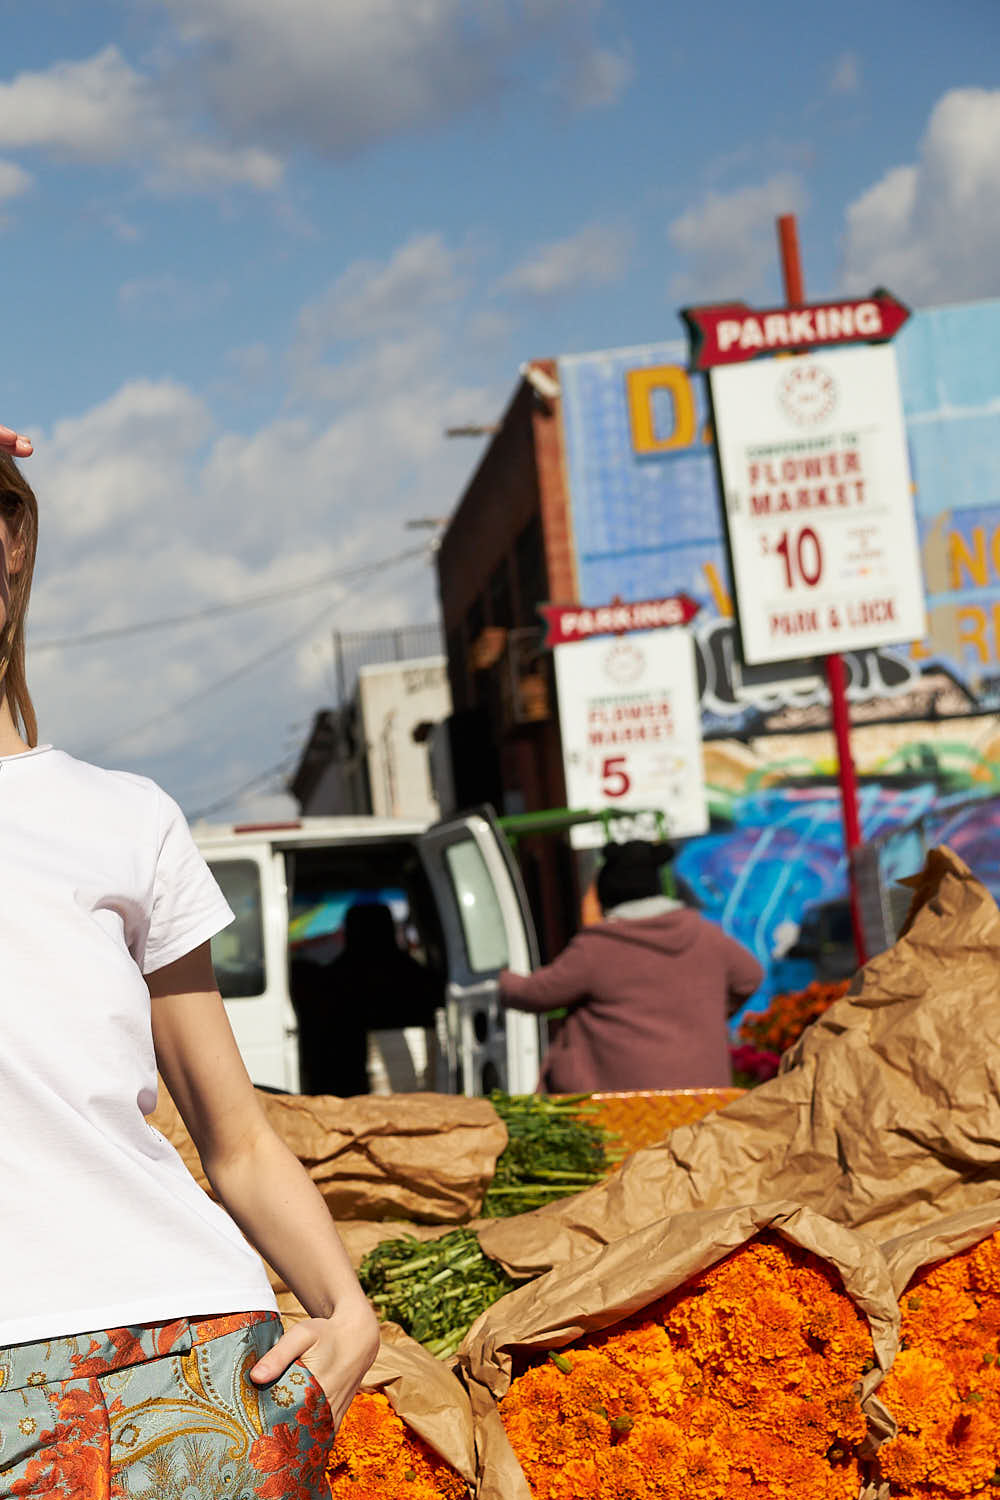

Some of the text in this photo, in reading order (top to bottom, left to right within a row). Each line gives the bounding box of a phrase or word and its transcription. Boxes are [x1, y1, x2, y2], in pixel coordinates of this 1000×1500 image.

[715, 302, 883, 351] PARKING
[625, 364, 712, 454] D
[748, 452, 860, 485] FLOWER
[750, 481, 865, 515] MARKET
[560, 599, 684, 636] PARKING
[770, 609, 818, 637] PARK
[848, 598, 897, 627] LOCK
